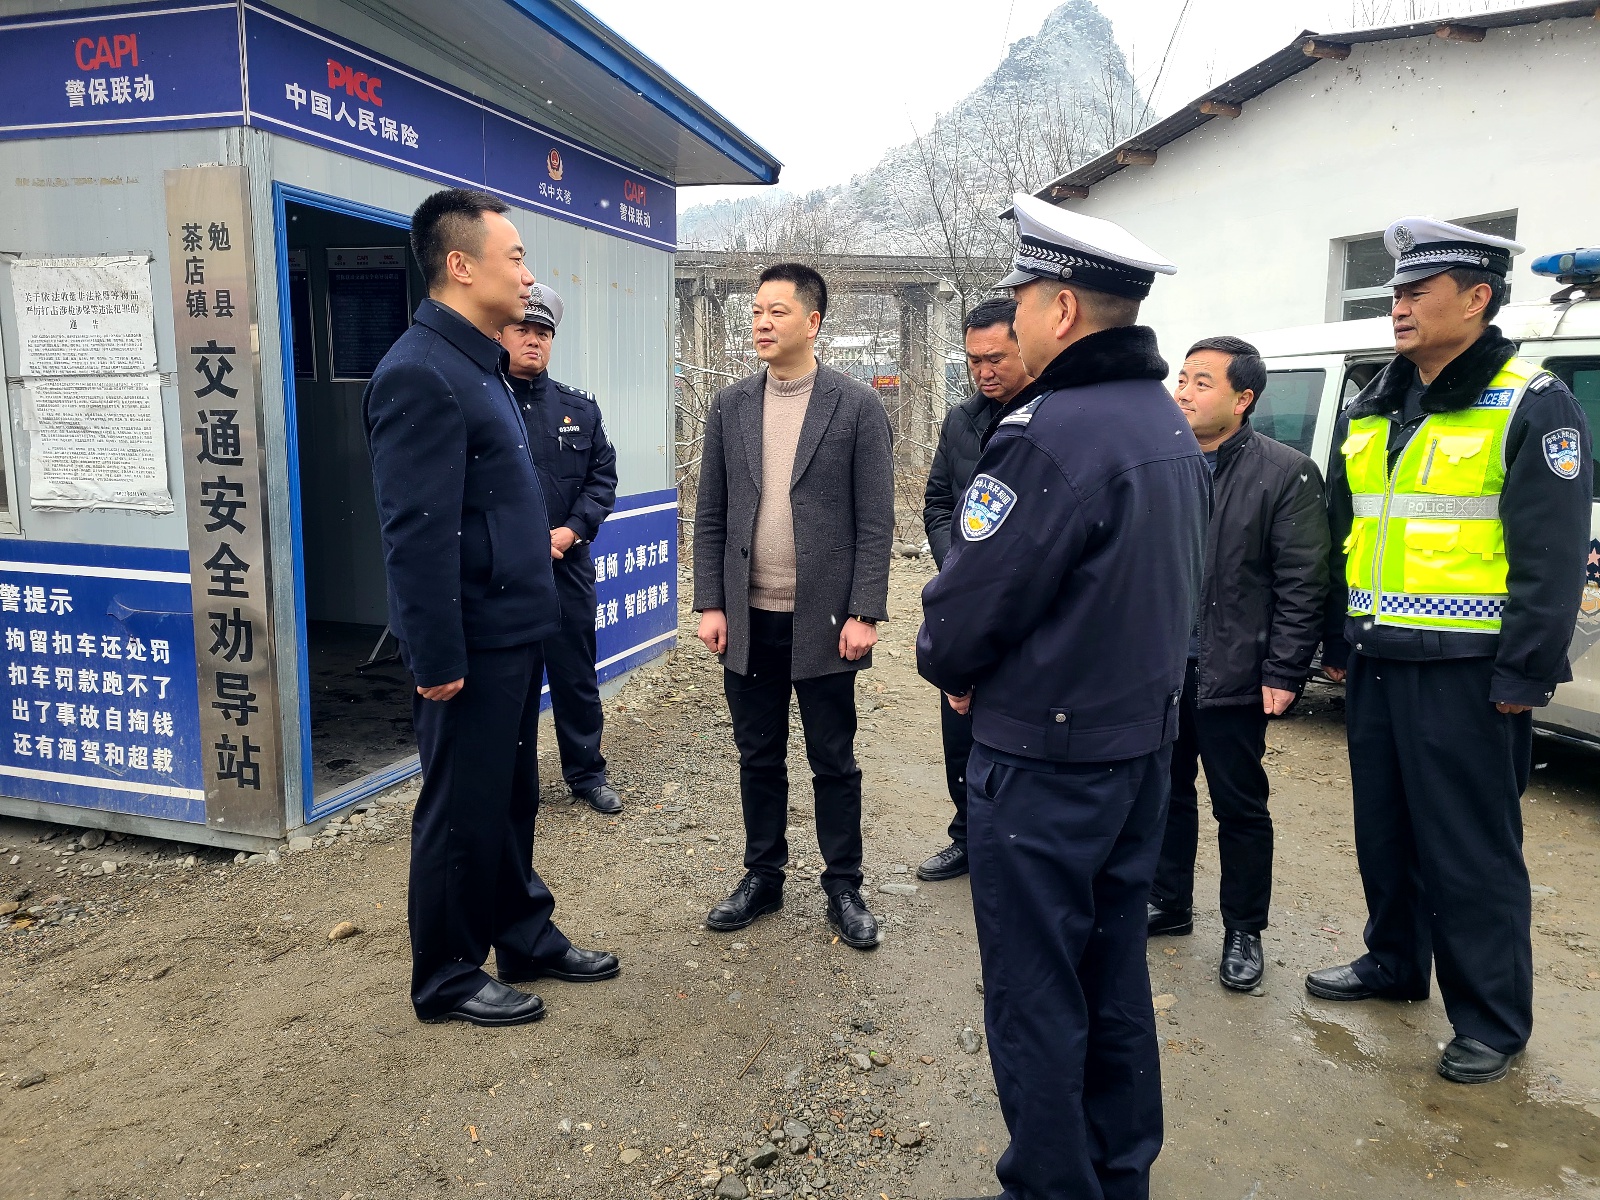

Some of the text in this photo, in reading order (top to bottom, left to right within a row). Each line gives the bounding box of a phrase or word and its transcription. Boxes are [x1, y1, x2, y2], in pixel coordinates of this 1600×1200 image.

[75, 34, 139, 71] CAPI
[65, 74, 155, 107] 警保联动
[327, 58, 383, 107] PICC
[285, 82, 419, 148] 中国人民保险
[624, 180, 647, 206] CAPI
[619, 202, 651, 228] 警保联动
[181, 222, 208, 318] 茶店镇
[208, 221, 235, 318] 勉县
[1408, 502, 1453, 512] POLICE
[191, 339, 261, 791] 交通安全劝导站
[595, 540, 669, 583] 通畅 办事方便
[595, 582, 669, 631] 高效 智能精准
[5, 627, 170, 664] 拘留扣车还处罚
[8, 663, 171, 699] 扣车罚款跑不了
[12, 698, 174, 737] 出了事故自掏钱
[13, 732, 173, 773] 还有酒驾和超载
